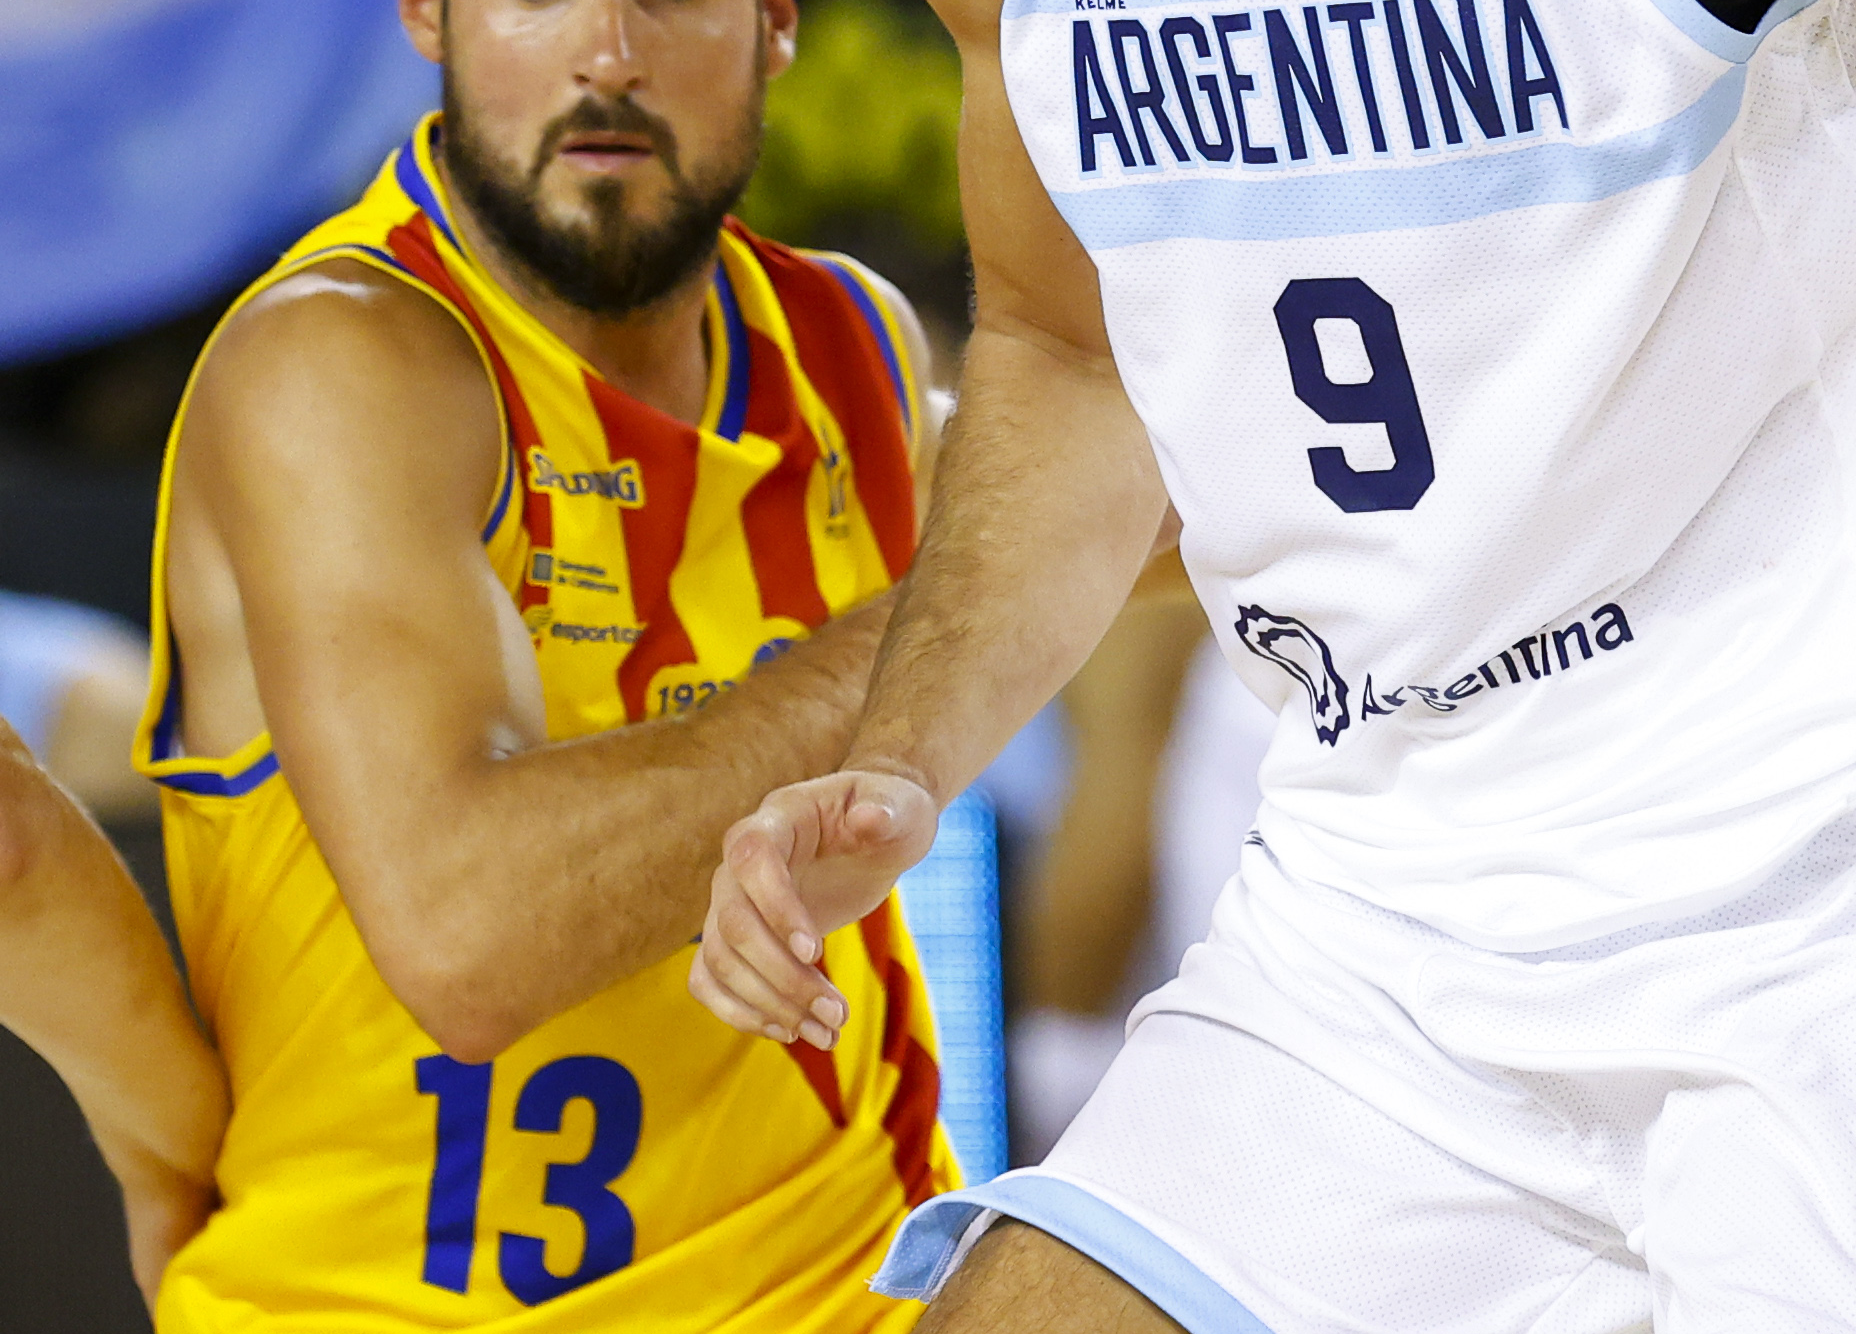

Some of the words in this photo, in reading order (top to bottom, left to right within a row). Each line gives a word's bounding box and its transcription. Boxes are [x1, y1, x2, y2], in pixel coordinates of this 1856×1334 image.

[1273, 278, 1436, 514] 9
[534, 452, 638, 502] SLDG
[658, 680, 738, 716] 192
[1360, 602, 1635, 722] Argentina
[414, 1053, 644, 1308] 13
